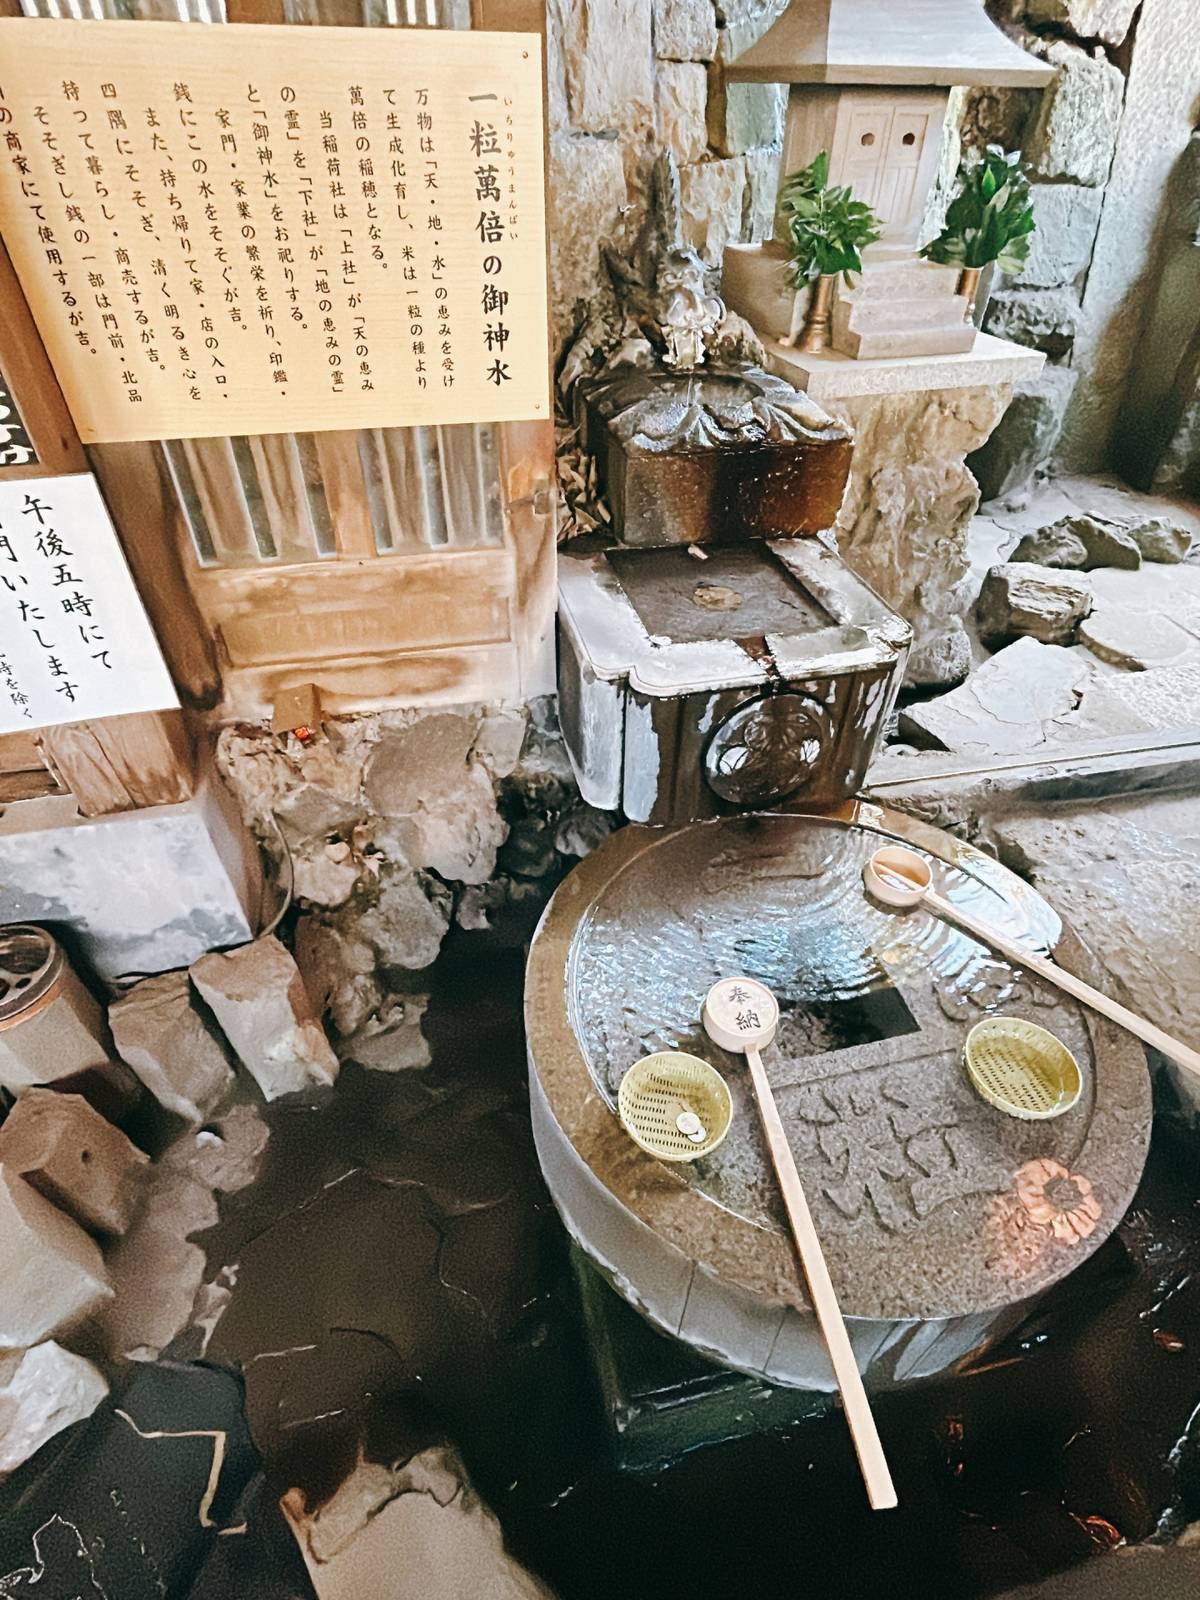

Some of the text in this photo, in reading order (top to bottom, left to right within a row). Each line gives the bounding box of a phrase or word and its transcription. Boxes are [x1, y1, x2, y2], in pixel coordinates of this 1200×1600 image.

[0, 87, 97, 355] の商家にて使用するが吉。
[172, 81, 248, 331] 銭にこの水をそそぐが吉。
[348, 84, 388, 270] 萬倍の稲穂となる。
[382, 88, 427, 390] て生成化育し、米は一粒の種より
[467, 92, 512, 387] 一粒萬倍の御神水
[21, 494, 112, 669] 午後五時にて
[728, 985, 761, 1030] 奉納
